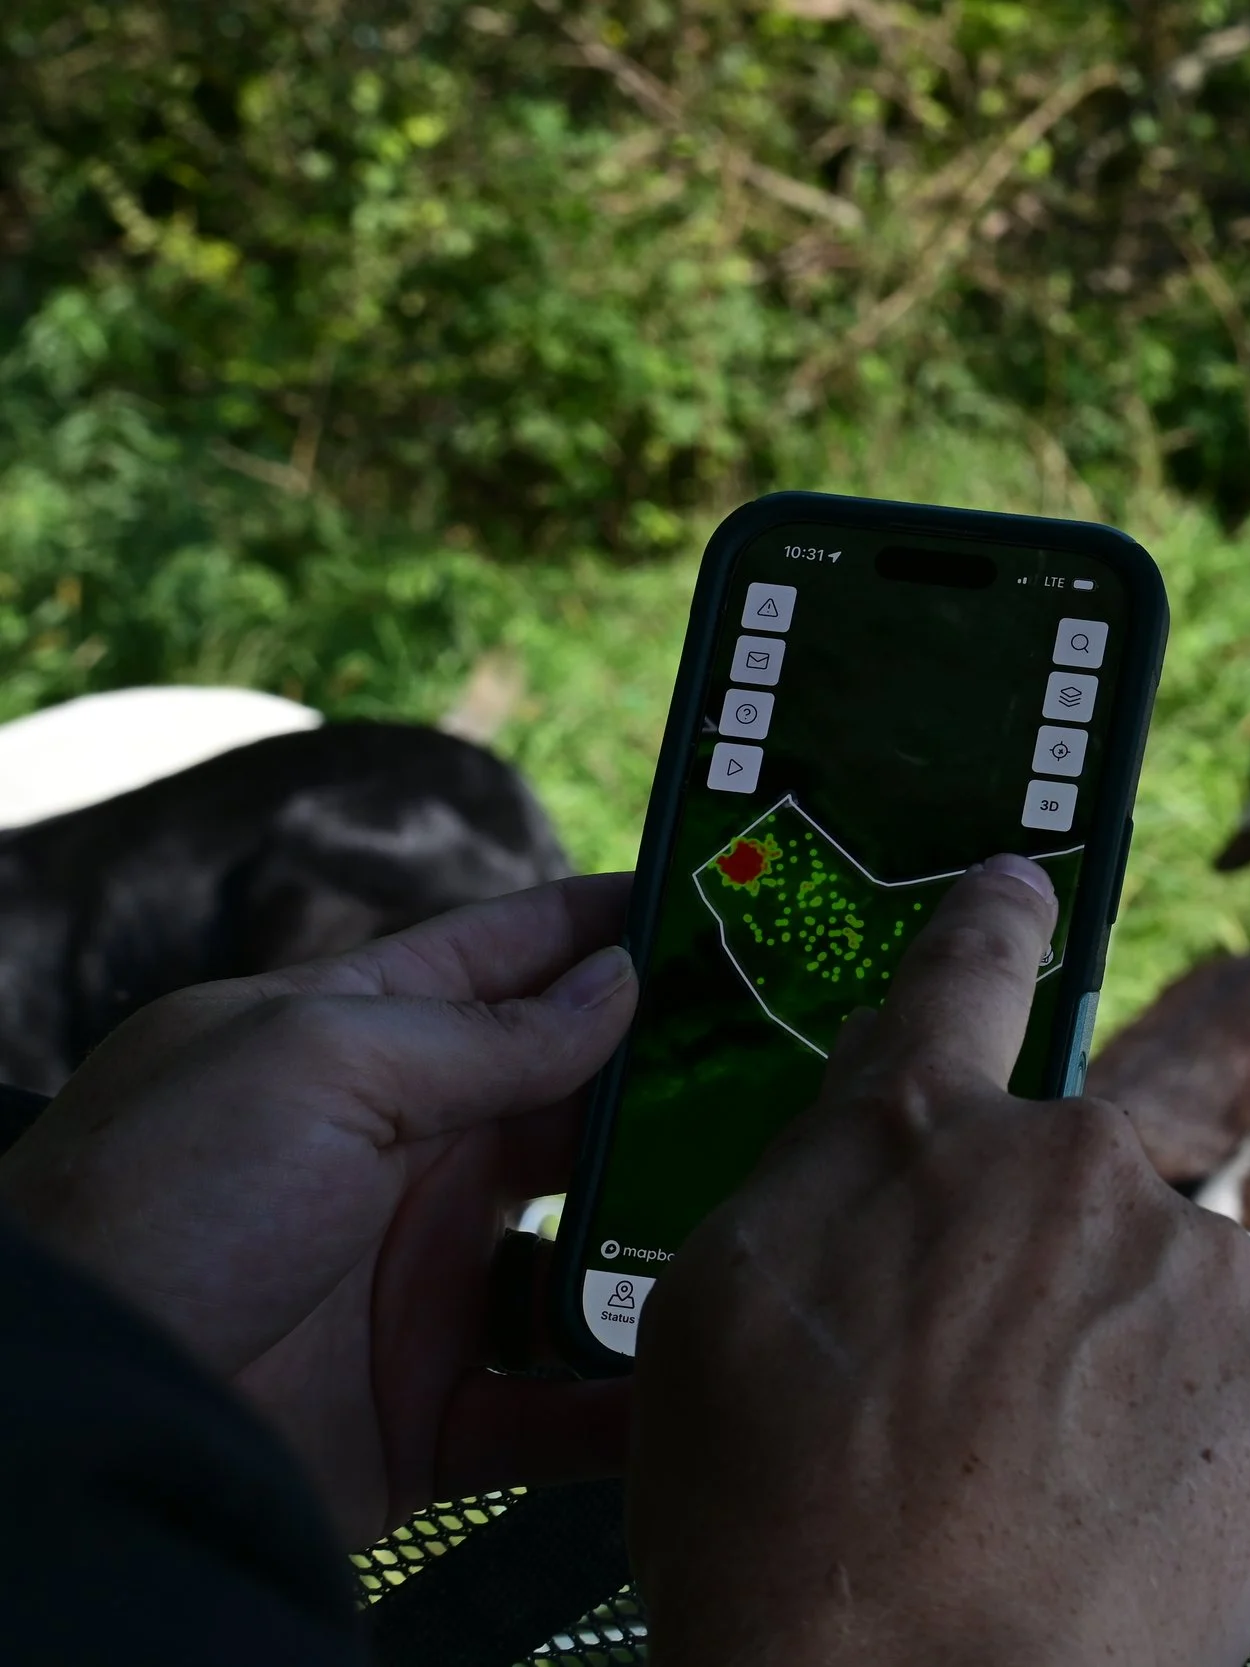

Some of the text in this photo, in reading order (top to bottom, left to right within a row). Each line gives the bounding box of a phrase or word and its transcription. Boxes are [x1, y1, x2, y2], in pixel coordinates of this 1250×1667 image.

[783, 545, 825, 562] 10:31
[1044, 576, 1066, 589] LTE
[1040, 800, 1059, 812] 3D
[601, 1311, 635, 1324] Status
